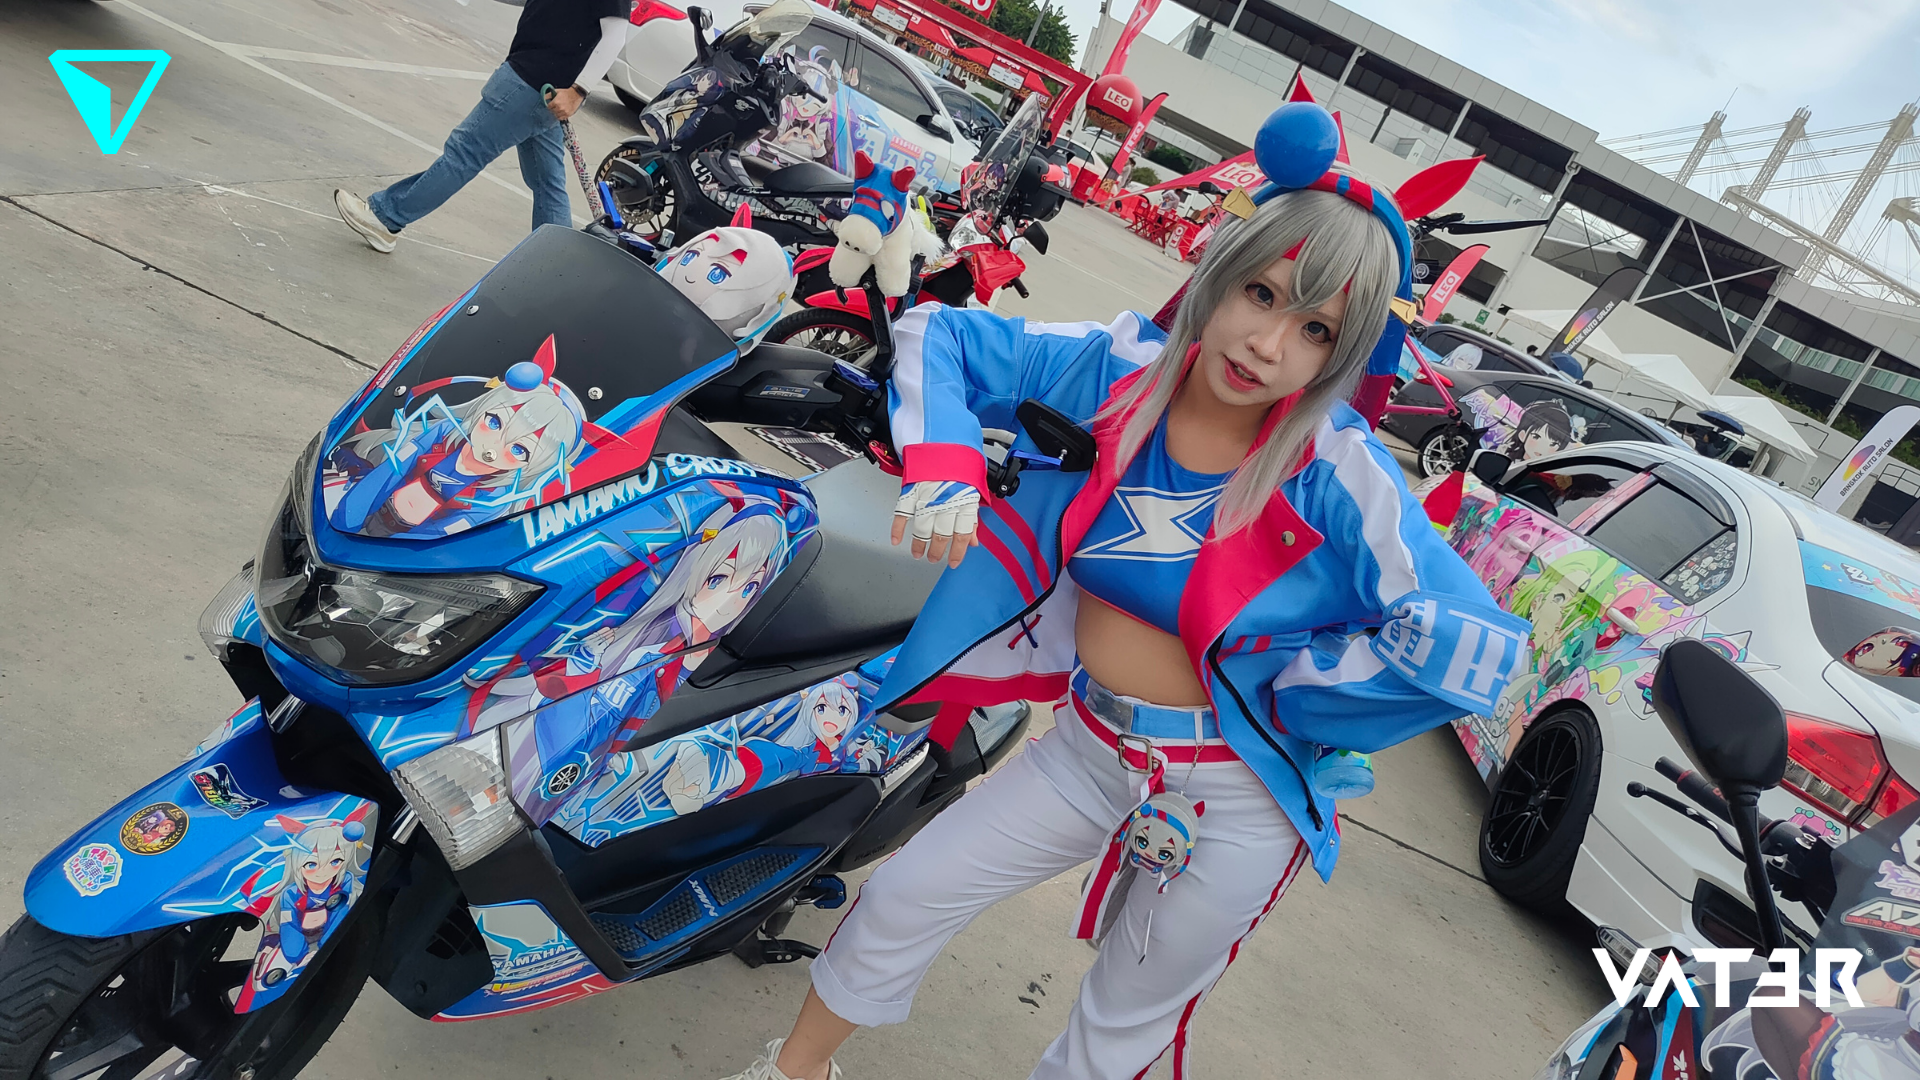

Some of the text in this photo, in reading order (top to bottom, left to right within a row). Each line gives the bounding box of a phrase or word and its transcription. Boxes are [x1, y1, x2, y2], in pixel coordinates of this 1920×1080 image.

[1107, 90, 1130, 108] LEO
[1219, 166, 1256, 185] LEO
[1169, 226, 1185, 248] LEO
[1436, 275, 1456, 299] LEO
[1582, 319, 1598, 336] AUTO
[1596, 301, 1615, 321] SALON
[666, 453, 757, 478] CROSS
[1839, 438, 1894, 497] BANGKOK AUTO SALON
[688, 879, 719, 917] NMAX
[493, 944, 567, 968] YAMAHA
